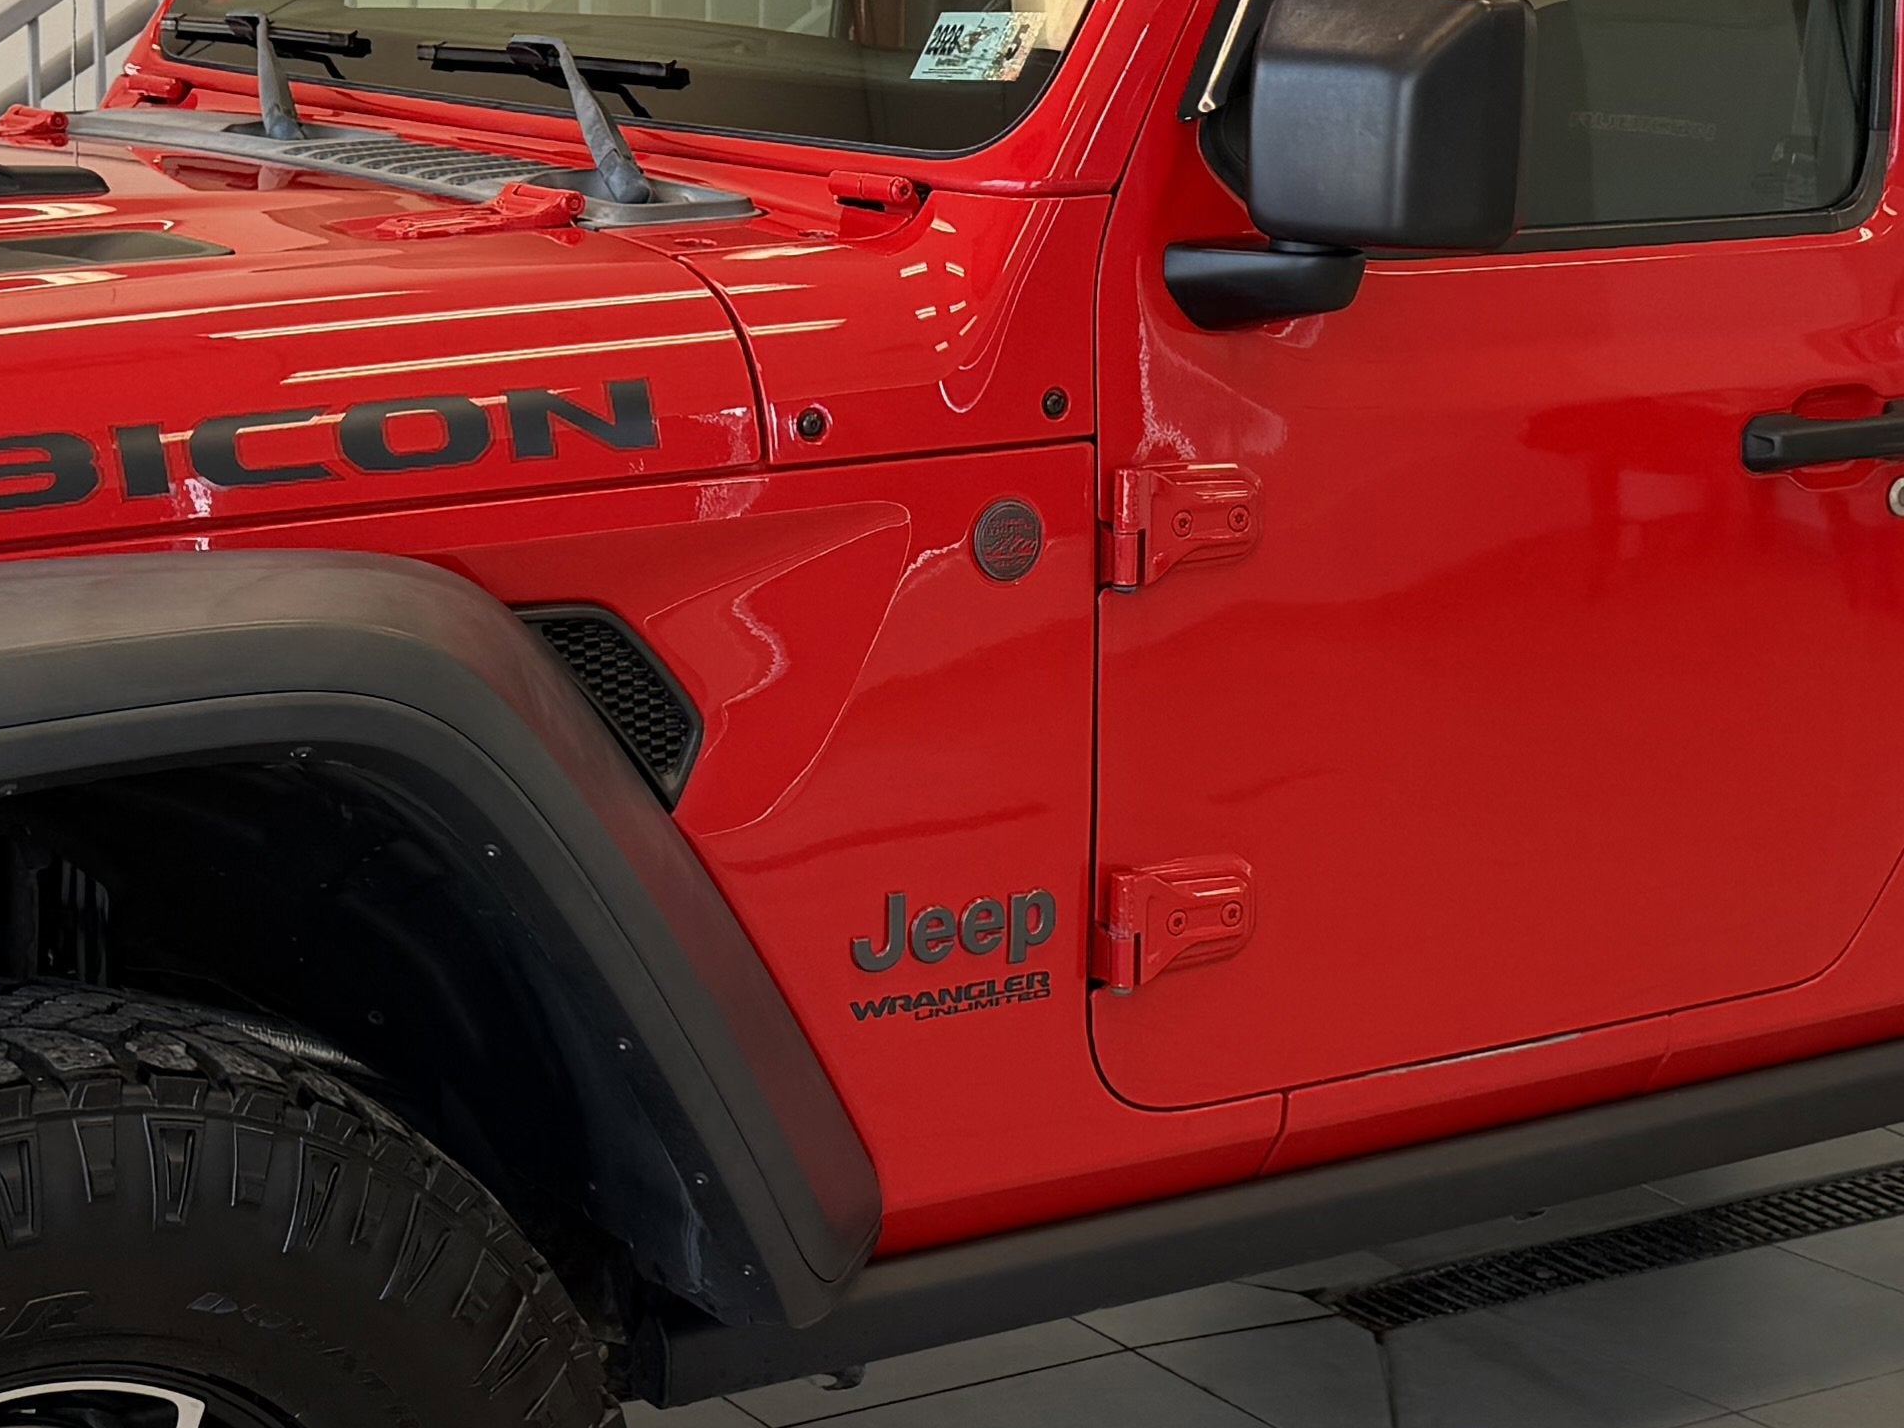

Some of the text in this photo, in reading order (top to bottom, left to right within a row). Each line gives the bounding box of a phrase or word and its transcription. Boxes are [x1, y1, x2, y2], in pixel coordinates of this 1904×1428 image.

[851, 887, 1057, 974] Jeep
[849, 970, 1051, 1022] WRANGLER
[914, 987, 1052, 1022] UNLIMITED
